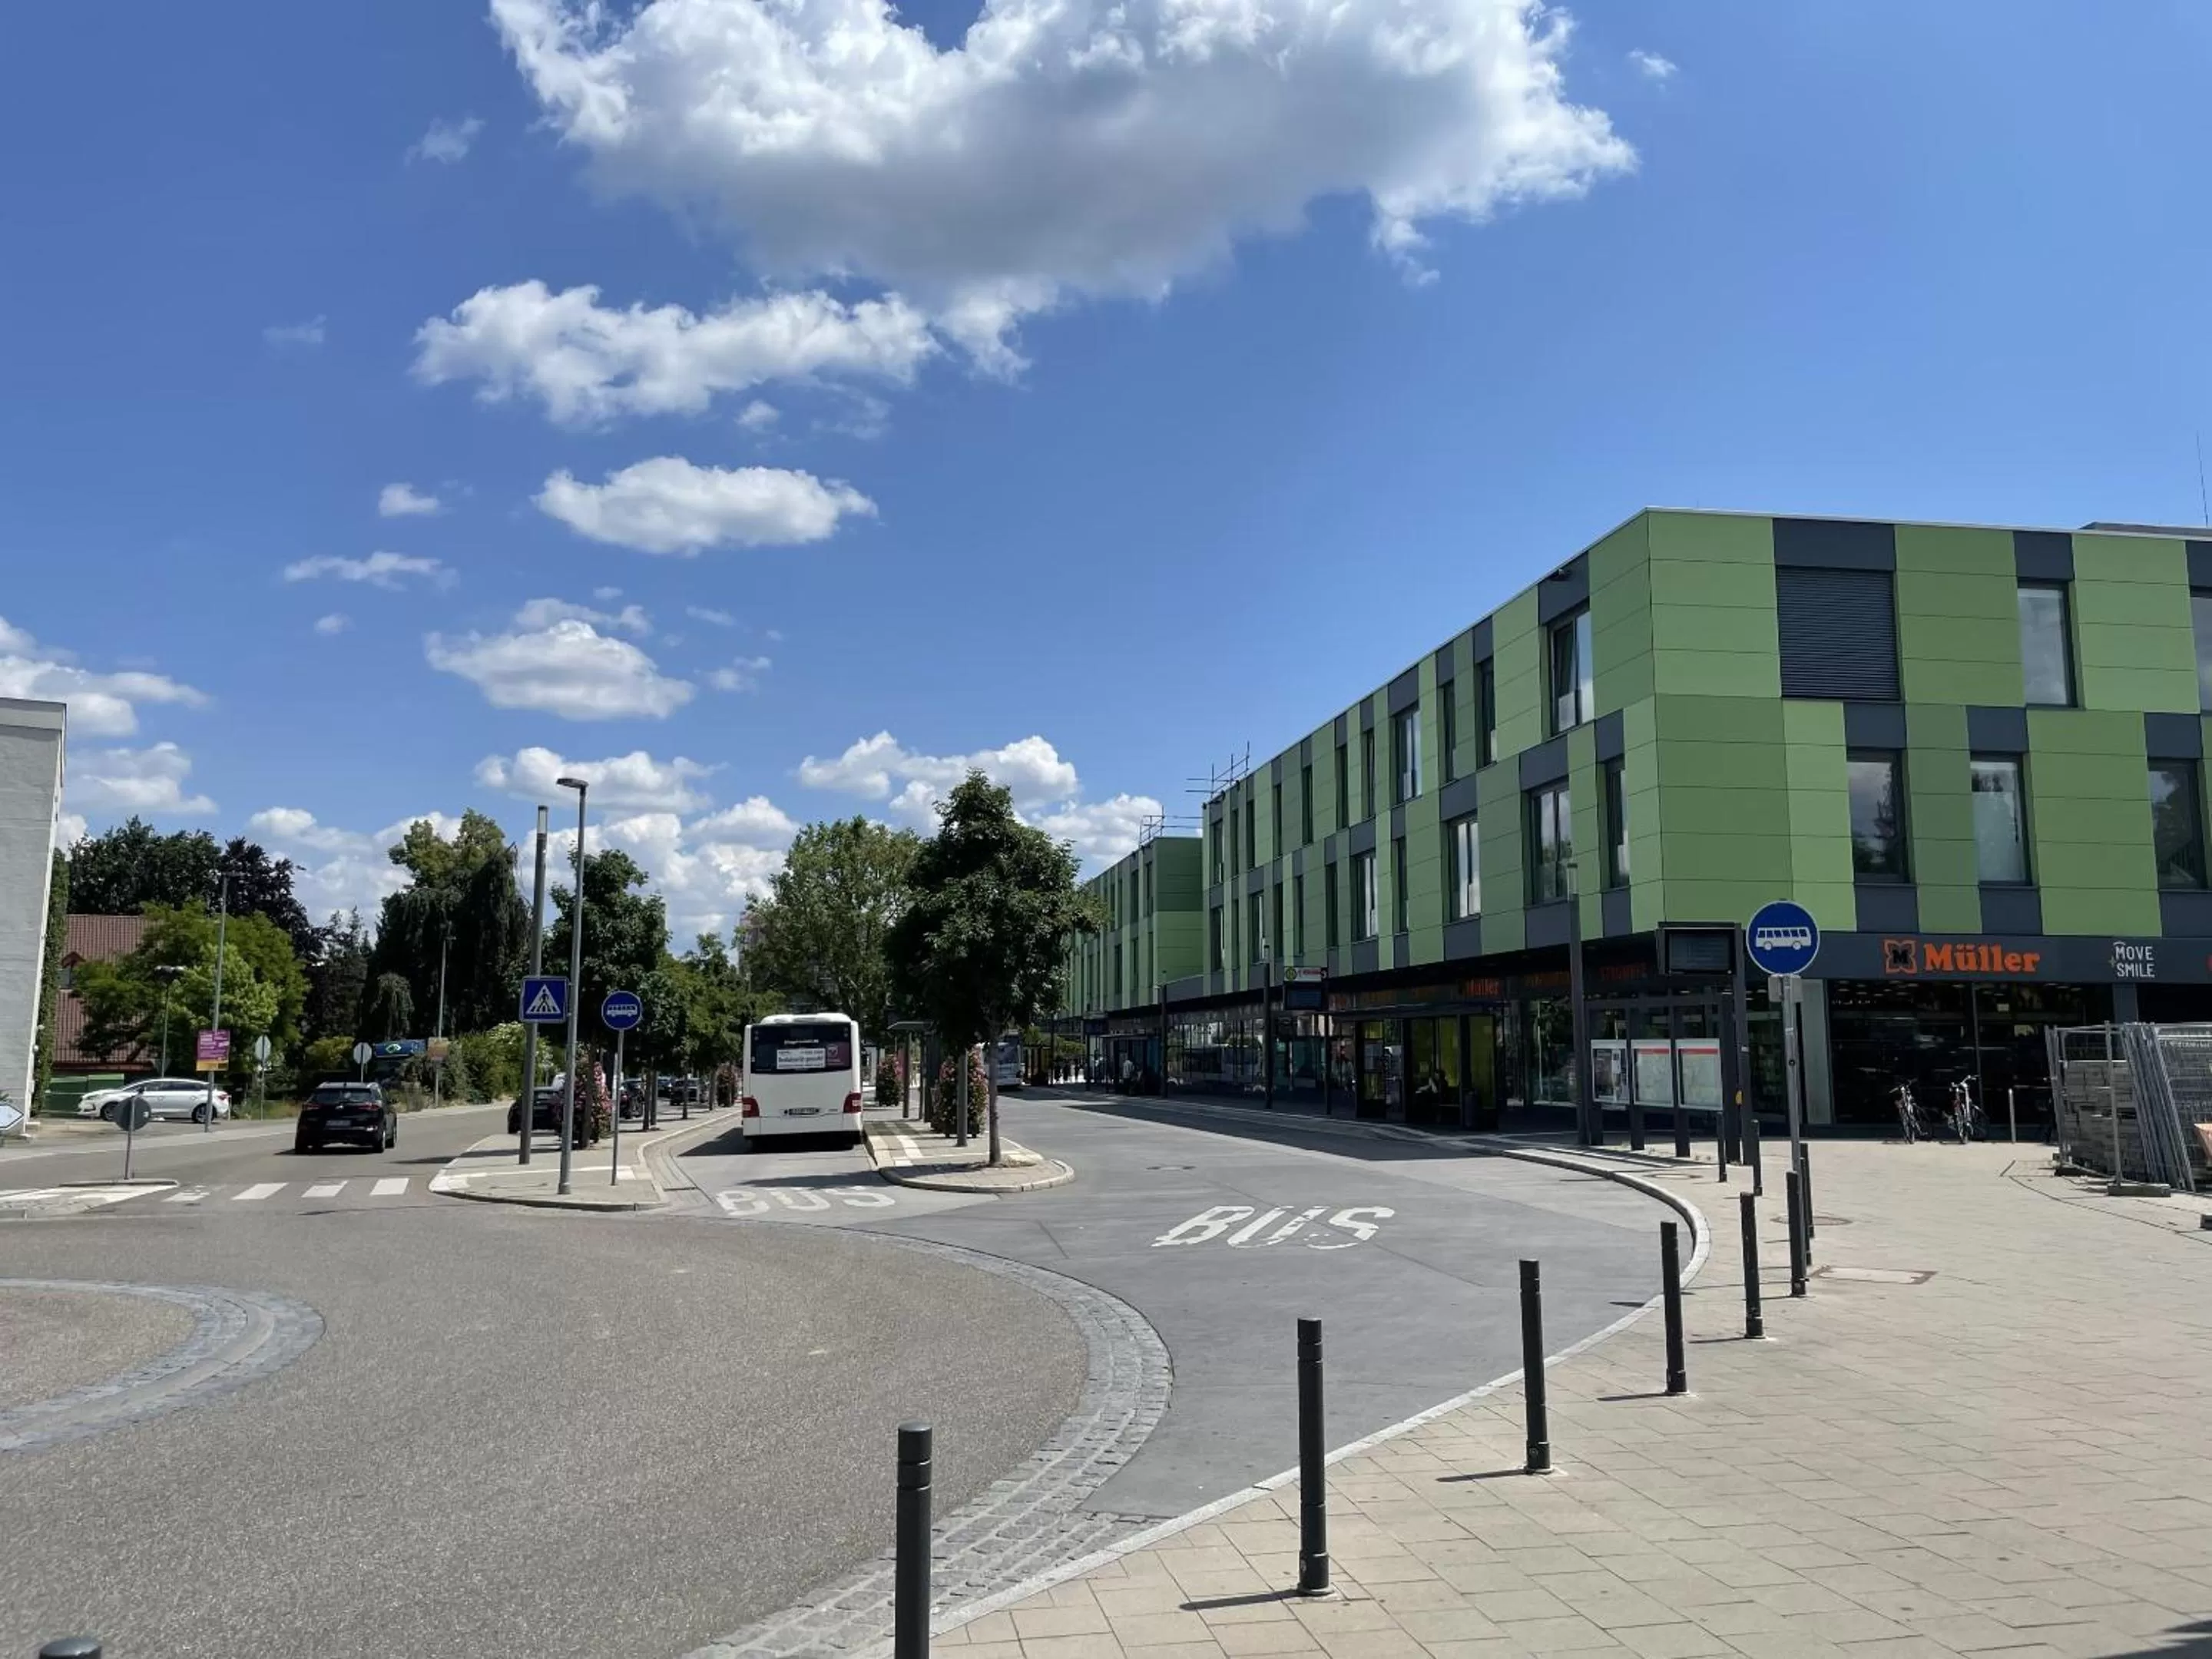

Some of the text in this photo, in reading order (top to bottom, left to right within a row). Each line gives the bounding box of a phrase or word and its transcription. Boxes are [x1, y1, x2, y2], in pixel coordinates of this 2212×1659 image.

[1923, 942, 2041, 972] Müller
[2115, 945, 2154, 961] MOVE
[2116, 962, 2155, 978] SMILE
[717, 1185, 896, 1216] BUS
[1151, 1205, 1395, 1250] BUS
